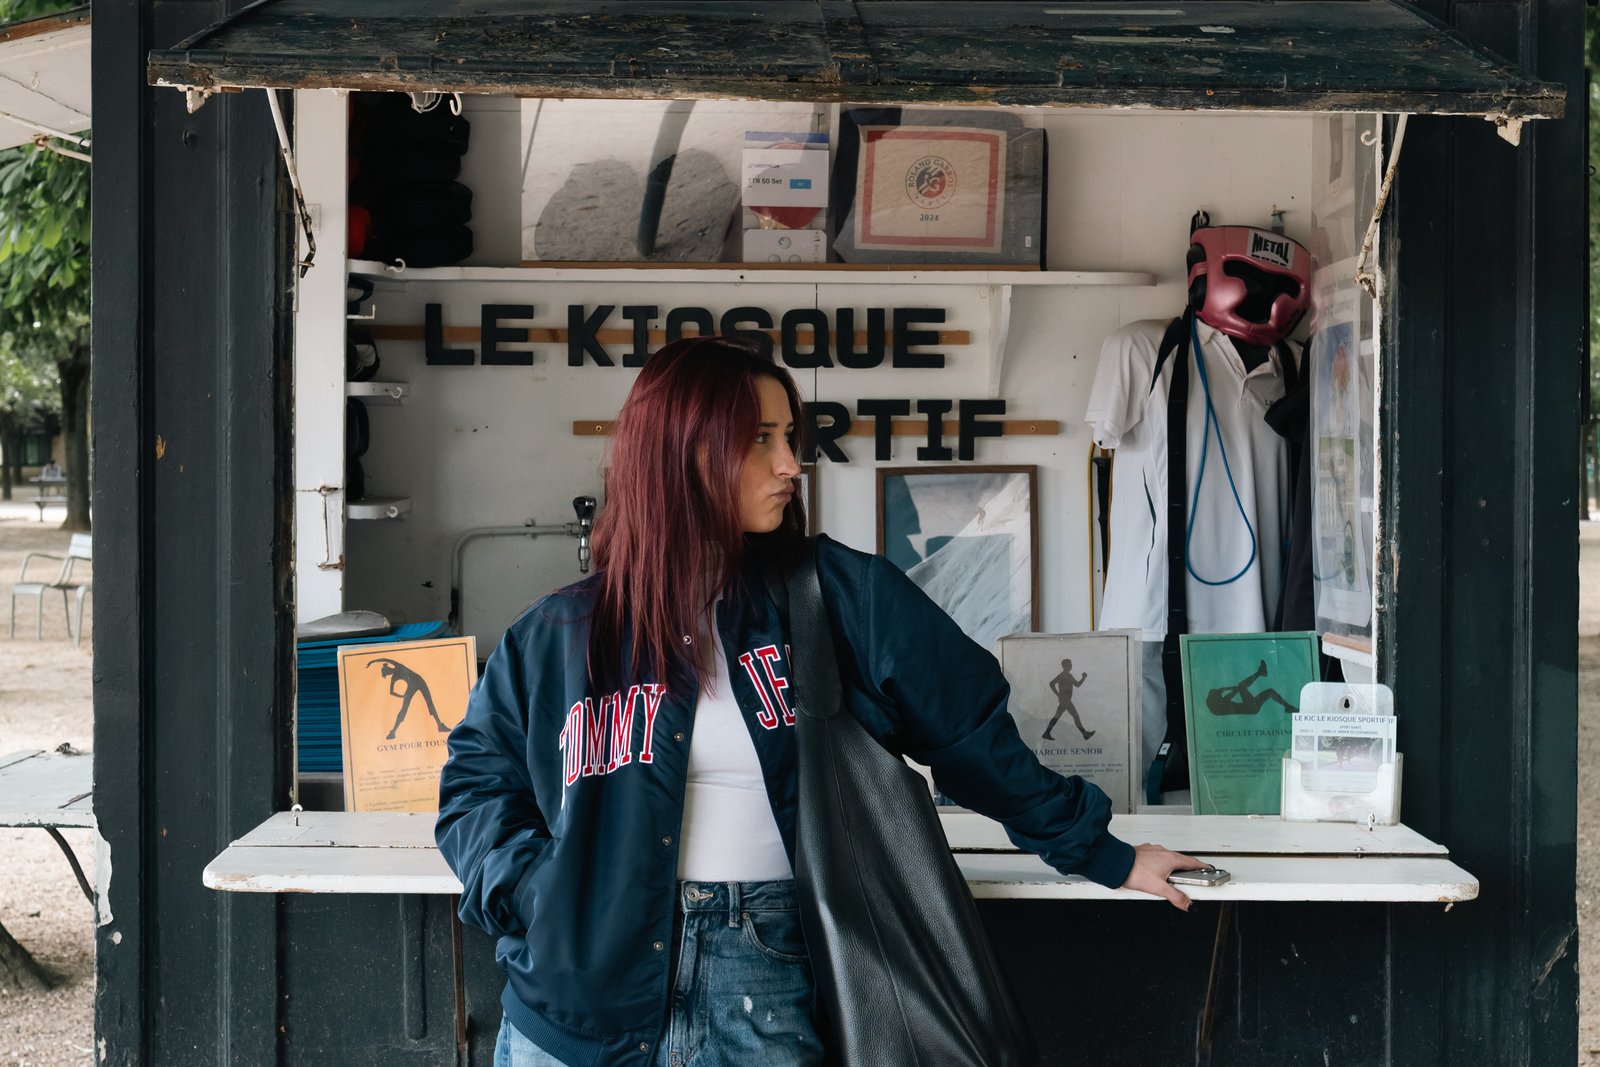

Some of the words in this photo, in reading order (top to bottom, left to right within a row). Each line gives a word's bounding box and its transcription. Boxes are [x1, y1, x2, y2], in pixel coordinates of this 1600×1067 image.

[908, 159, 931, 188] ROLAND
[933, 159, 954, 188] GARROS
[761, 177, 771, 185] 50
[771, 177, 783, 185] Set
[920, 213, 939, 221] 2024
[1251, 232, 1290, 264] METAL
[425, 303, 534, 366] LE
[567, 304, 946, 369] KIOSQUE
[801, 399, 1006, 463] RTIF
[1326, 715, 1357, 723] KIOSQUE
[1357, 716, 1386, 724] SPORTIF
[1216, 729, 1252, 738] CIRCUIT
[376, 744, 397, 752] GYM
[399, 742, 423, 750] POUR
[424, 739, 448, 748] TOUS
[1070, 747, 1103, 755] SENIOR
